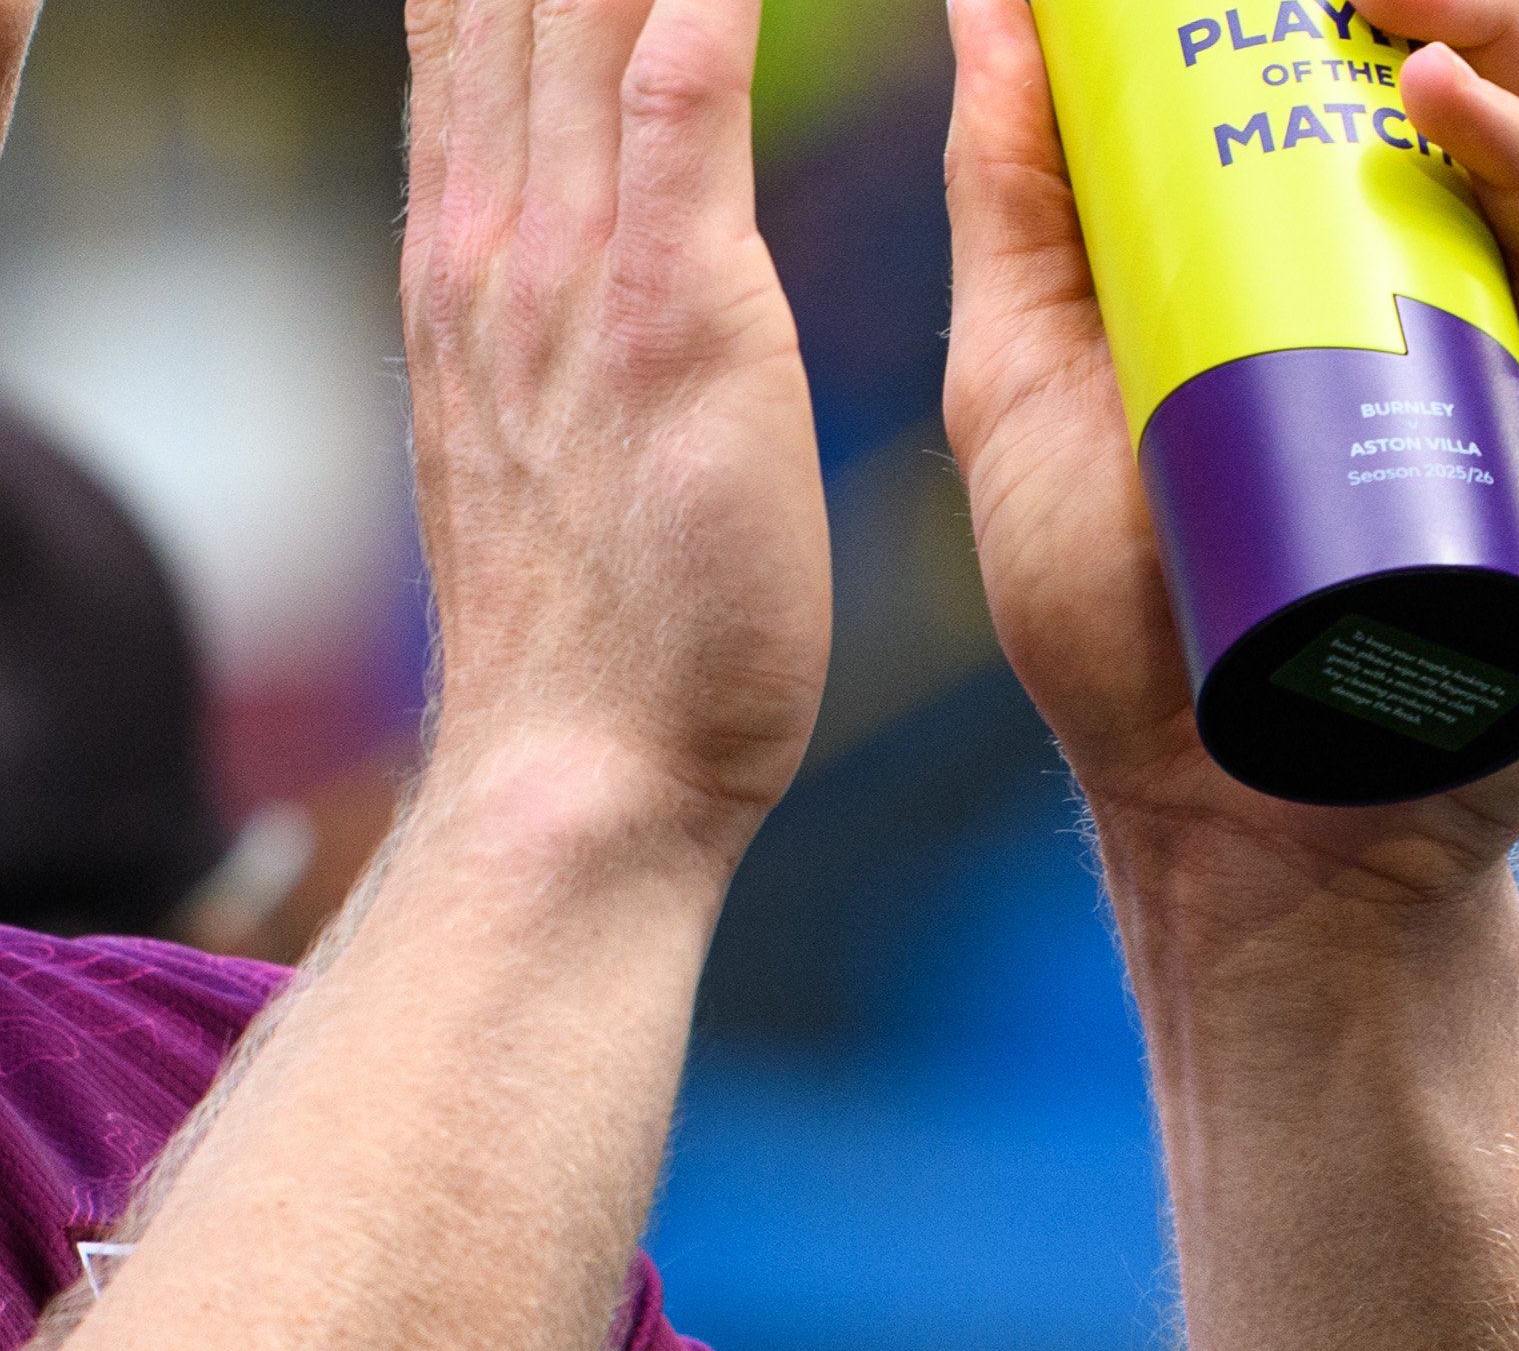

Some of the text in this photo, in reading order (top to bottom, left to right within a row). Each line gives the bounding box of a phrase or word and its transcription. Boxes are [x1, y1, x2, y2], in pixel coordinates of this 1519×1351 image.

[1262, 60, 1396, 88] OF THE
[1360, 400, 1455, 419] BURNLEY
[1350, 436, 1483, 457] ASTON VILLA
[1347, 463, 1495, 486] Season 2025/26
[1452, 670, 1490, 691] looking
